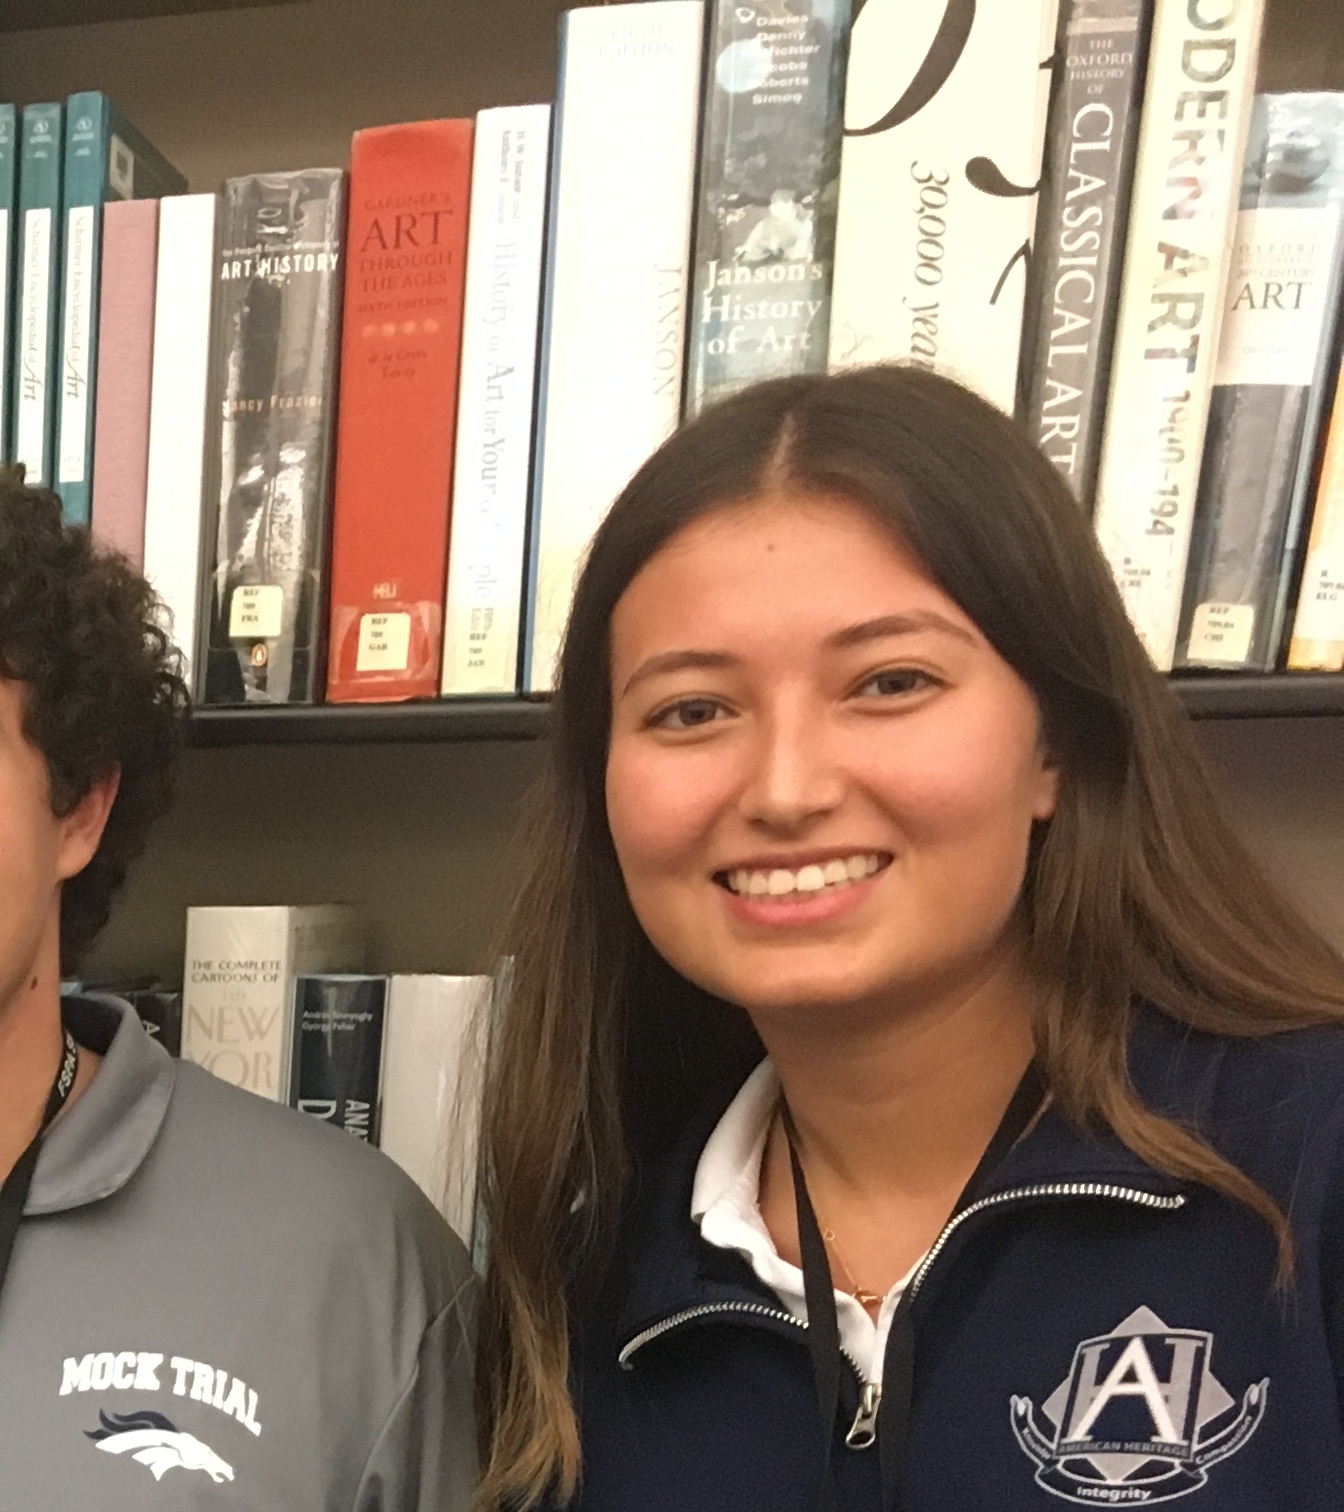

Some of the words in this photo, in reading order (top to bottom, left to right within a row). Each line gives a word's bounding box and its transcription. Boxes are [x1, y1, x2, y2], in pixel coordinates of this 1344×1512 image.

[1089, 39, 1112, 50] THE
[1066, 53, 1133, 68] OXFORD
[1070, 69, 1125, 80] HISTORY
[1087, 84, 1104, 95] OF
[360, 210, 454, 253] ART
[1046, 102, 1114, 368] CLASSICAL
[221, 260, 252, 280] ART
[257, 253, 339, 278] HISTORY
[360, 251, 453, 273] THROUGH
[362, 276, 397, 293] THE
[401, 271, 448, 289] AGES
[702, 260, 823, 296] Janson's
[701, 295, 823, 324] History
[1144, 241, 1209, 374] ART
[1231, 281, 1313, 311] ART
[653, 264, 682, 397] JANSON
[707, 326, 744, 354] of
[757, 325, 812, 352] Art
[23, 355, 44, 401] Art
[66, 352, 87, 399] Art
[484, 360, 515, 402] Art
[1039, 379, 1083, 475] ART
[191, 960, 215, 970] THE
[218, 960, 281, 971] COMPLETE
[191, 972, 258, 984] CARTOONS
[263, 972, 280, 984] OF
[186, 1005, 281, 1045] NEW
[59, 1351, 164, 1396] MOCK
[170, 1356, 263, 1437] TRIAL
[1076, 1486, 1152, 1501] Integrity
